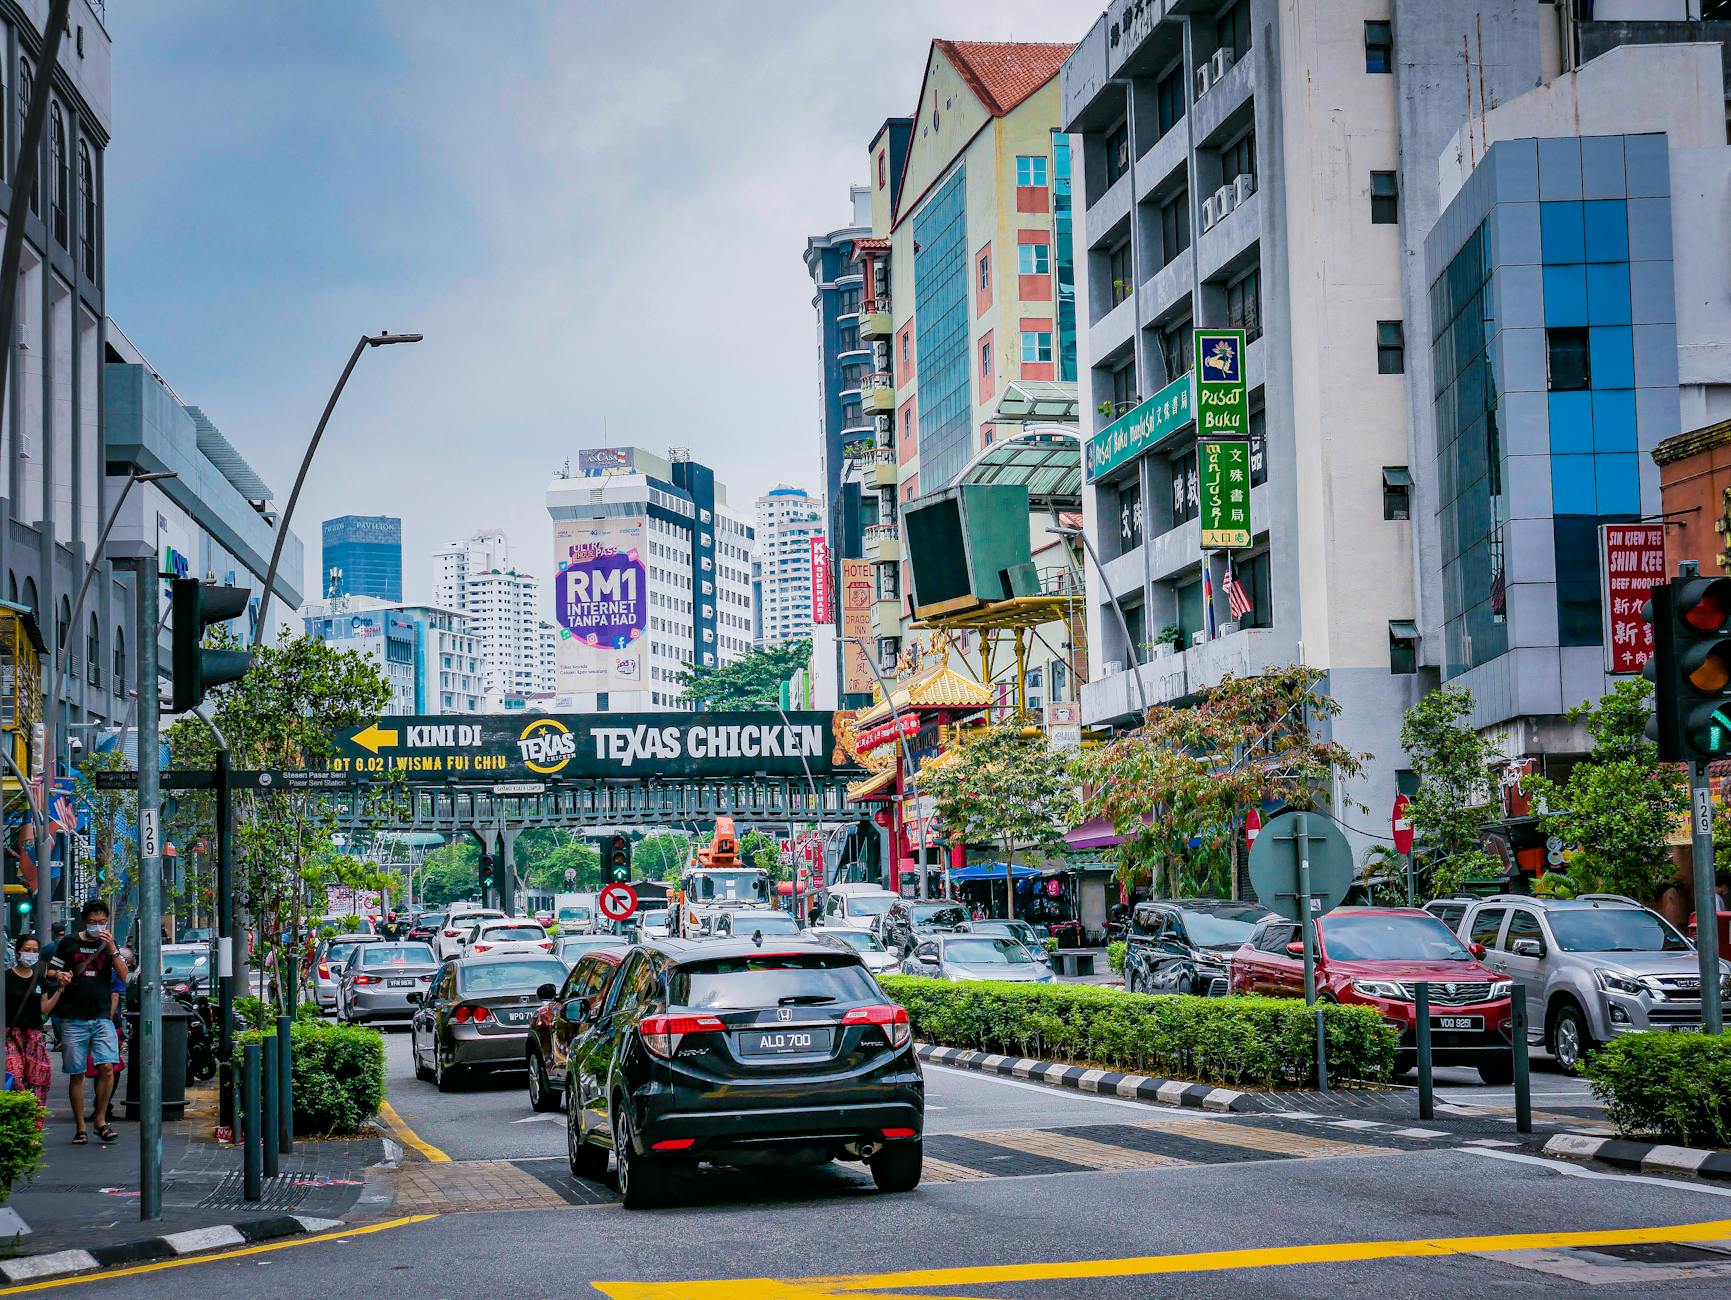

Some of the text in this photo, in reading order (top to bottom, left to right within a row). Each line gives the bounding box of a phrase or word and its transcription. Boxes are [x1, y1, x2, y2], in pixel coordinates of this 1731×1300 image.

[1229, 449, 1244, 522] 文殊書局
[357, 522, 394, 531] PAVILION
[1609, 531, 1662, 547] SIN KIEW YEE
[574, 542, 604, 553] ULTRA
[595, 547, 618, 558] PASS
[1610, 550, 1663, 573] SHIN KEE
[843, 564, 875, 577] HOTEL
[567, 568, 637, 603] RM1
[813, 542, 826, 620] KK SUPERMART
[1611, 577, 1630, 589] BEEF
[567, 601, 637, 616] INTERNET
[567, 613, 637, 628] TANPA HAD
[845, 615, 871, 625] DRAGO
[854, 626, 866, 634] INN
[1621, 651, 1653, 666] 牛肉
[407, 725, 482, 747] KINI DI
[516, 732, 576, 763] TEXAS
[590, 724, 681, 766] TEXAS
[687, 725, 823, 758] CHICKEN
[396, 757, 442, 770] WISMA
[447, 756, 469, 770] FUI
[474, 755, 506, 769] CHIU
[1700, 792, 1709, 831] 129
[145, 812, 154, 855] 129
[1440, 1018, 1455, 1028] VDQ
[760, 1034, 811, 1048] ALQ 700
